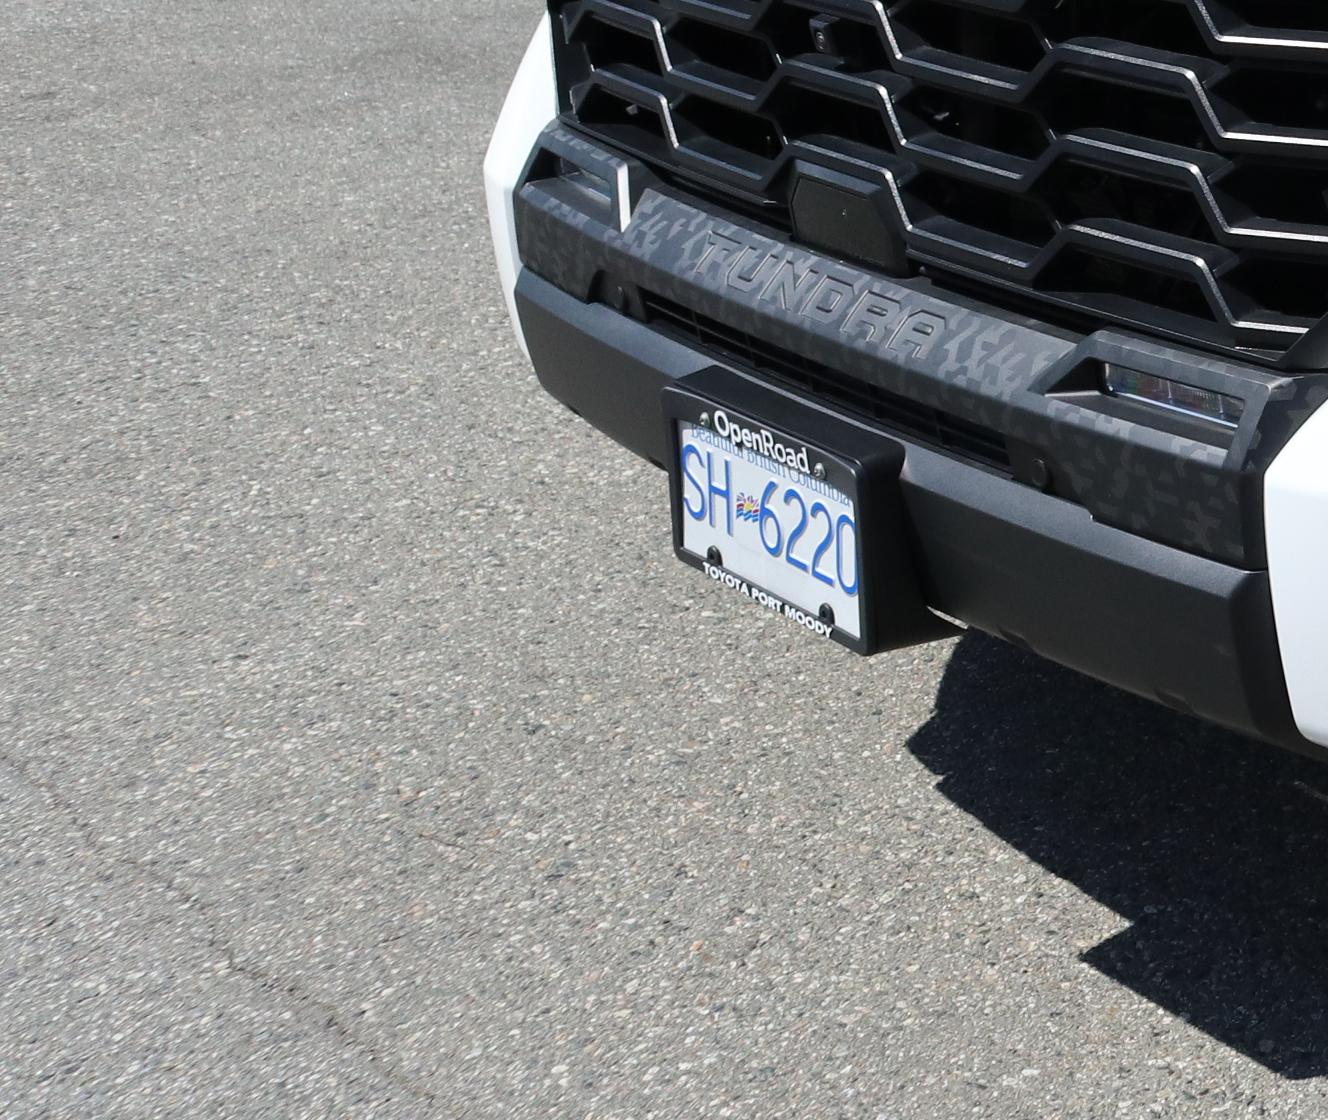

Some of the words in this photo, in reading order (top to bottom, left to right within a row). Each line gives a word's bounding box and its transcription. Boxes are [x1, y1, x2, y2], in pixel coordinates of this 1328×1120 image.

[694, 230, 950, 360] TUNDRA
[713, 410, 811, 474] OpenRoad
[681, 443, 733, 537] SH
[759, 480, 858, 596] 6220
[702, 562, 750, 597] TOYOTA
[751, 587, 784, 613] PORT
[784, 604, 833, 638] MOODY
